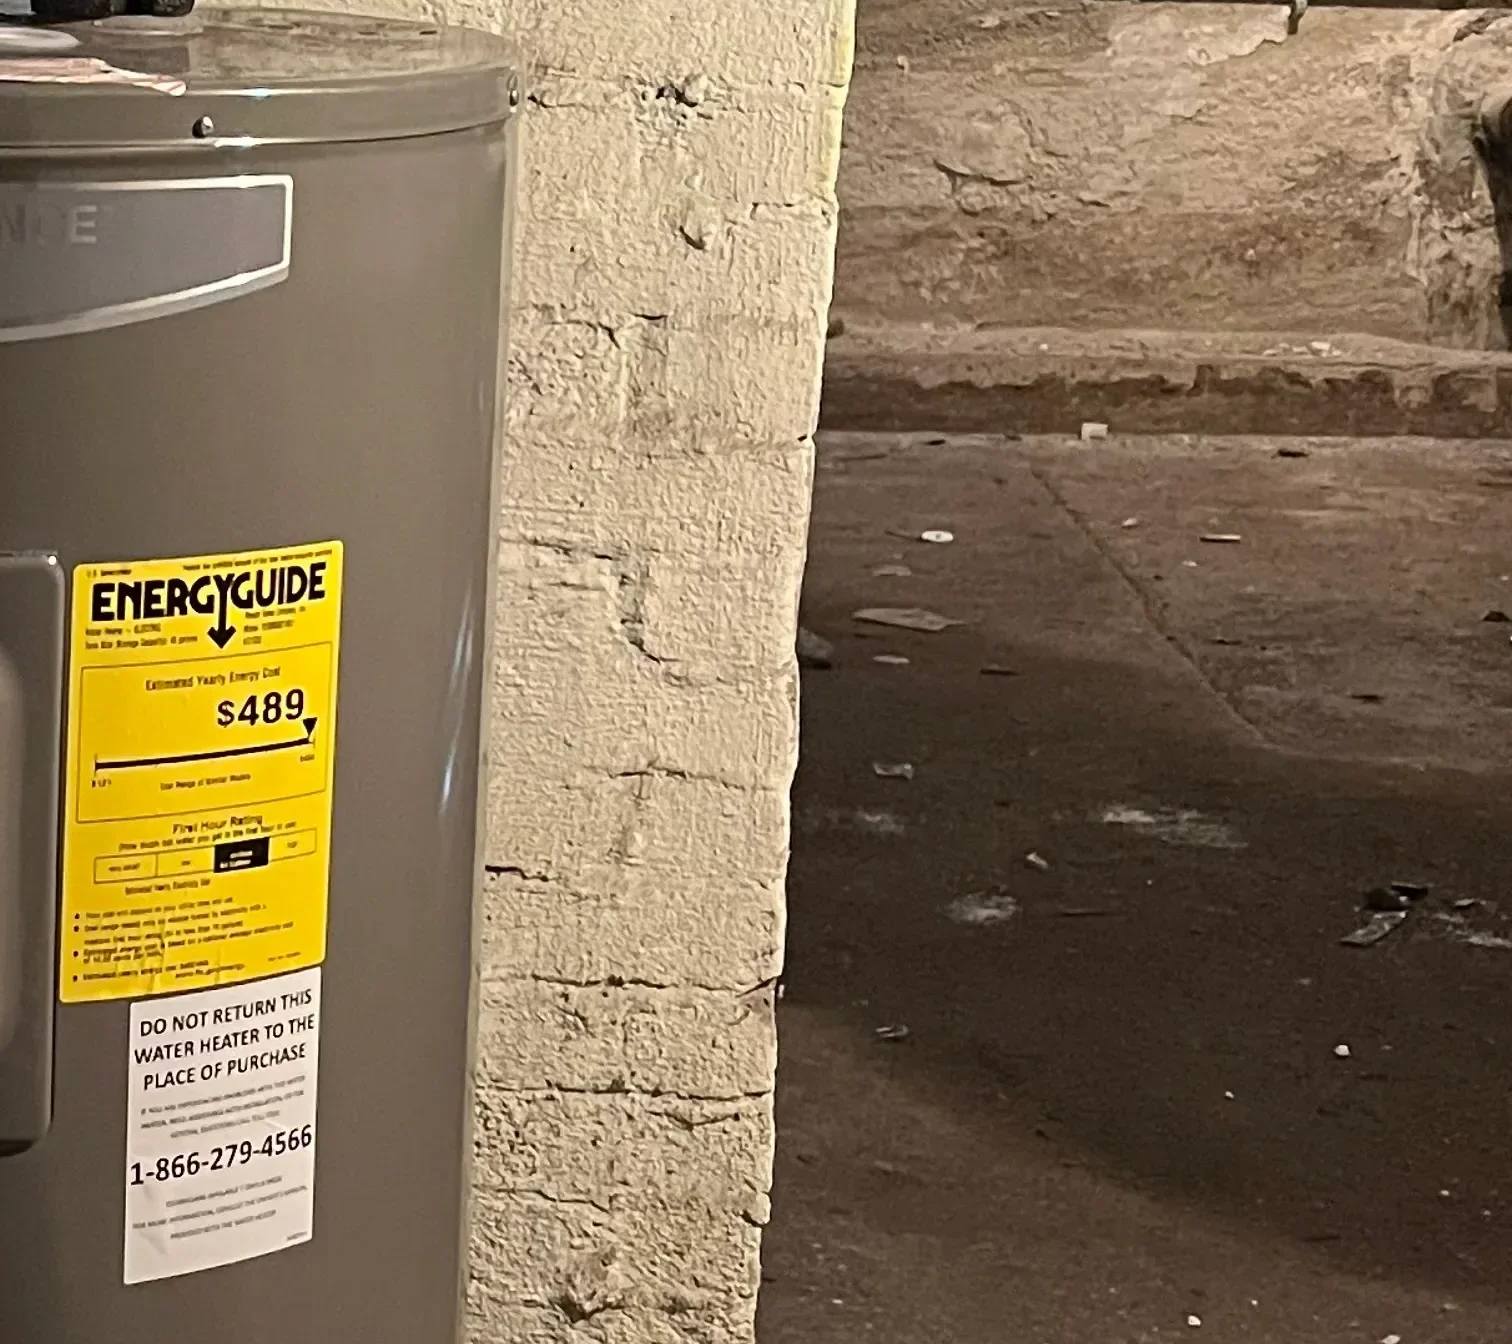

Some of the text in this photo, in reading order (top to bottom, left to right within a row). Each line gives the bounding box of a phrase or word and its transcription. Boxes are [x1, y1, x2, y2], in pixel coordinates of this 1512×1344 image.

[91, 562, 327, 622] ENERGYGUIDE
[217, 689, 304, 728] $489
[140, 988, 313, 1037] DO NOT RETURN THIS
[134, 1014, 316, 1065] WATER HEATER TO THE
[143, 1042, 307, 1091] PLACE OF PURCHASE
[130, 1124, 313, 1186] 1-866-279-4566
